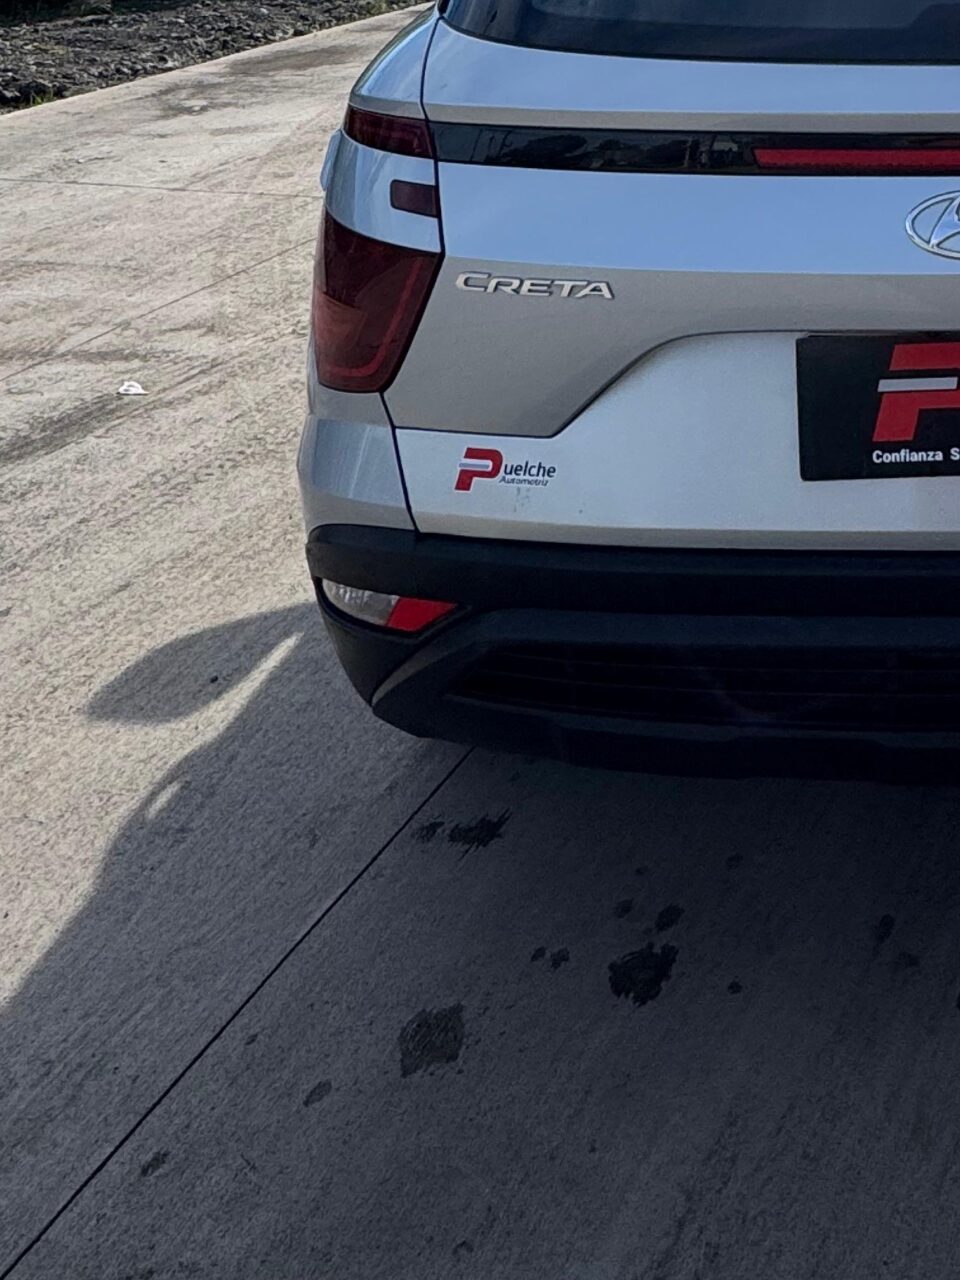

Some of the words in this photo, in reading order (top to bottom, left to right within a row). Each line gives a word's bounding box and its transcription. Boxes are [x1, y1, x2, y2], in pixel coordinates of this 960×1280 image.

[455, 271, 616, 299] CRETA
[872, 448, 943, 464] Confianza
[454, 447, 556, 491] Puelche
[499, 477, 549, 487] Automotriz
